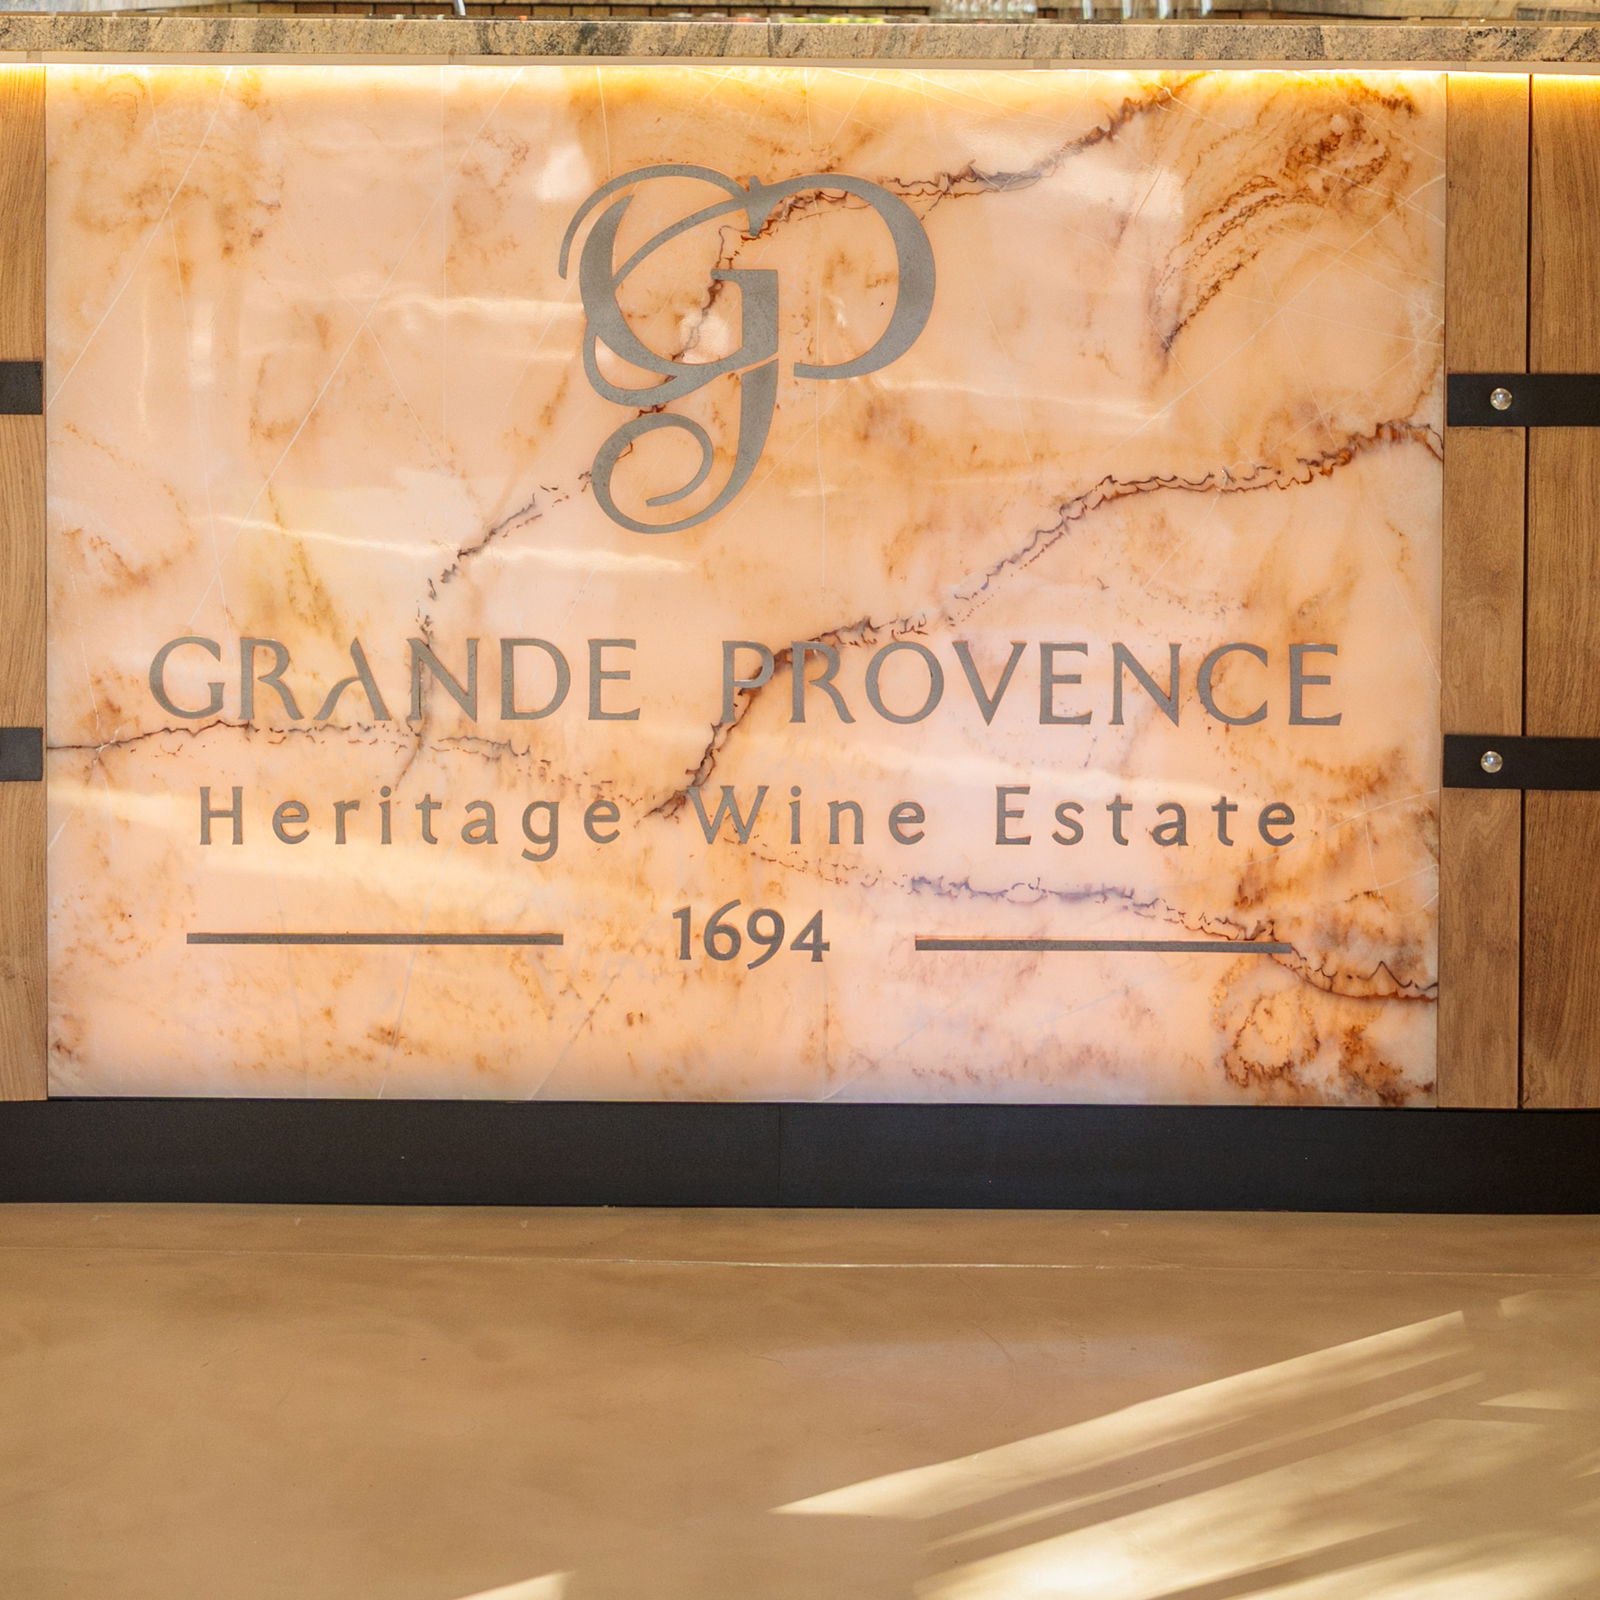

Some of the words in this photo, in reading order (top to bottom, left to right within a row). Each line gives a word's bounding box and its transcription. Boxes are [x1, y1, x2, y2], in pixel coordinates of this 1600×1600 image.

[148, 636, 641, 722] GRANDE
[719, 640, 1343, 727] PROVENCE
[199, 786, 620, 862] Heritage
[685, 785, 926, 846] Wine
[995, 786, 1295, 847] Estate
[672, 899, 830, 970] 1694
